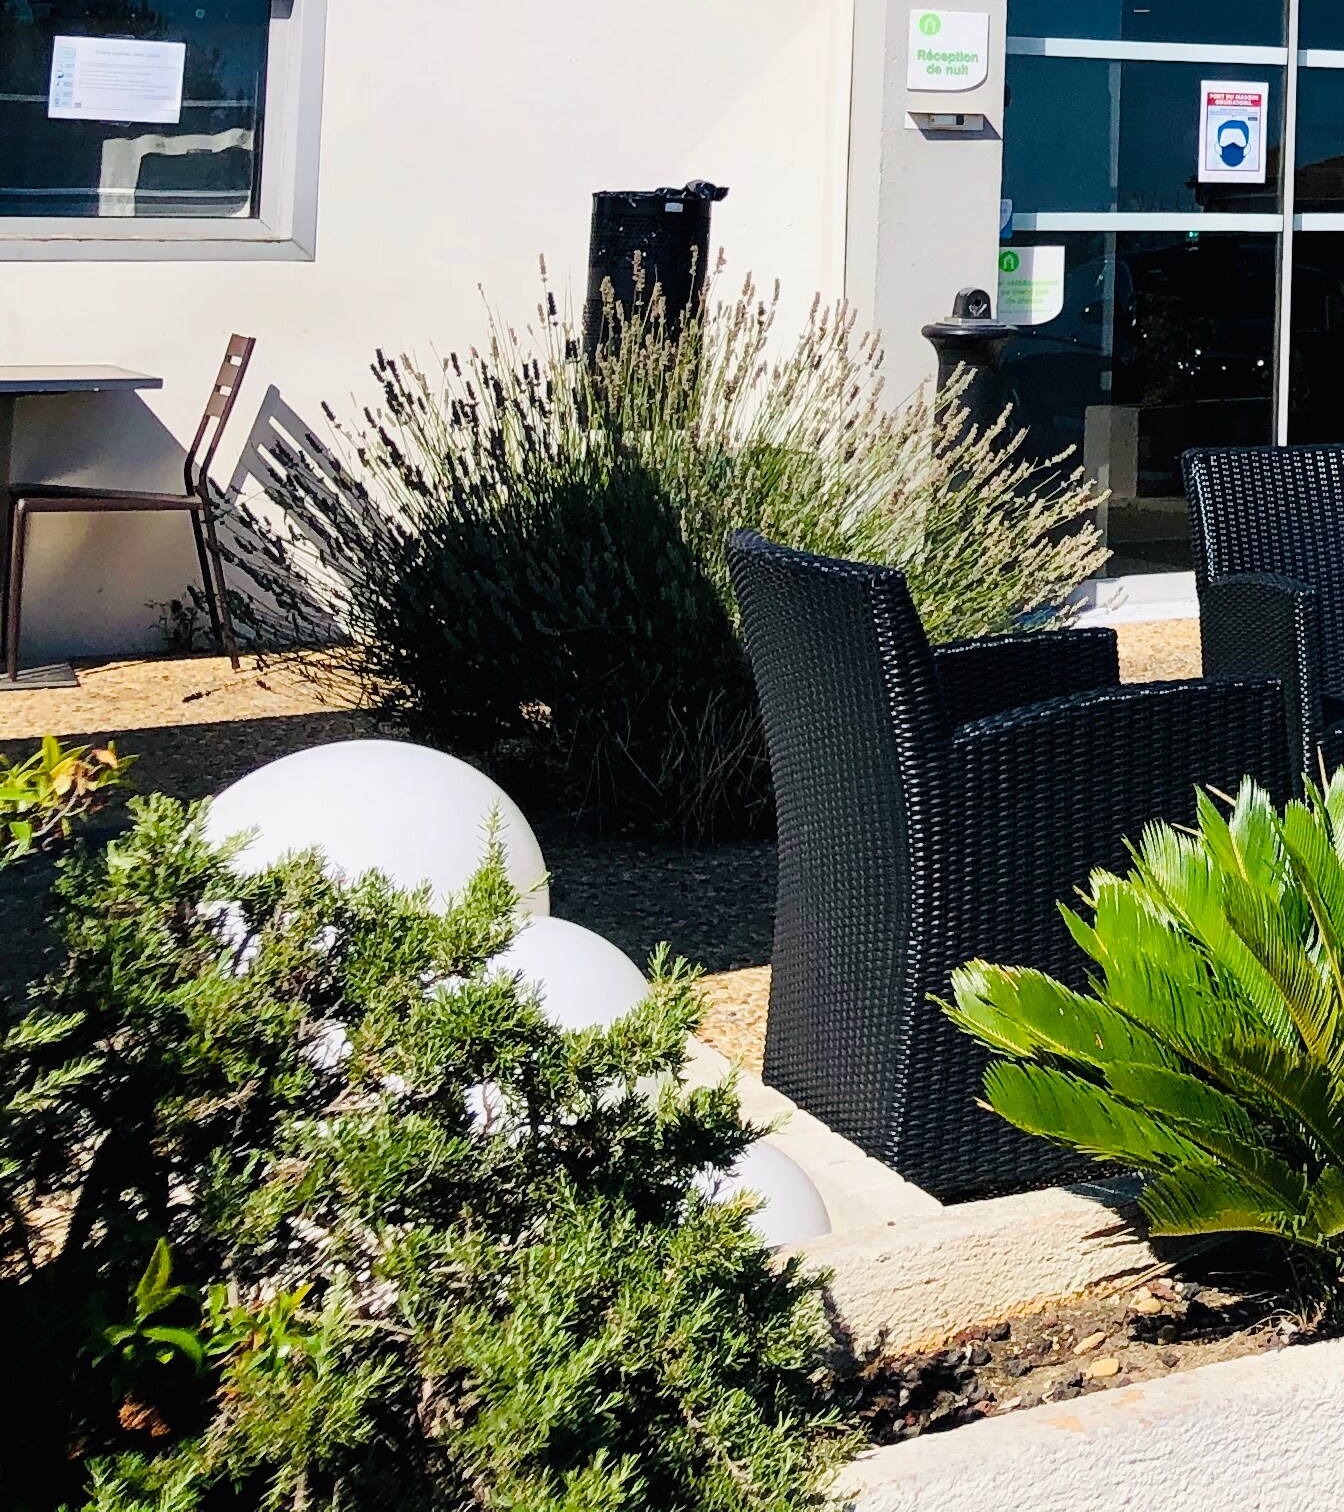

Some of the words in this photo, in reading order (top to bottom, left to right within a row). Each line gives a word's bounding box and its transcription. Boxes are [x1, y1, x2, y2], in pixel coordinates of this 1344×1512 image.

[916, 48, 980, 65] Réception
[926, 63, 943, 75] de
[945, 64, 970, 76] nuit
